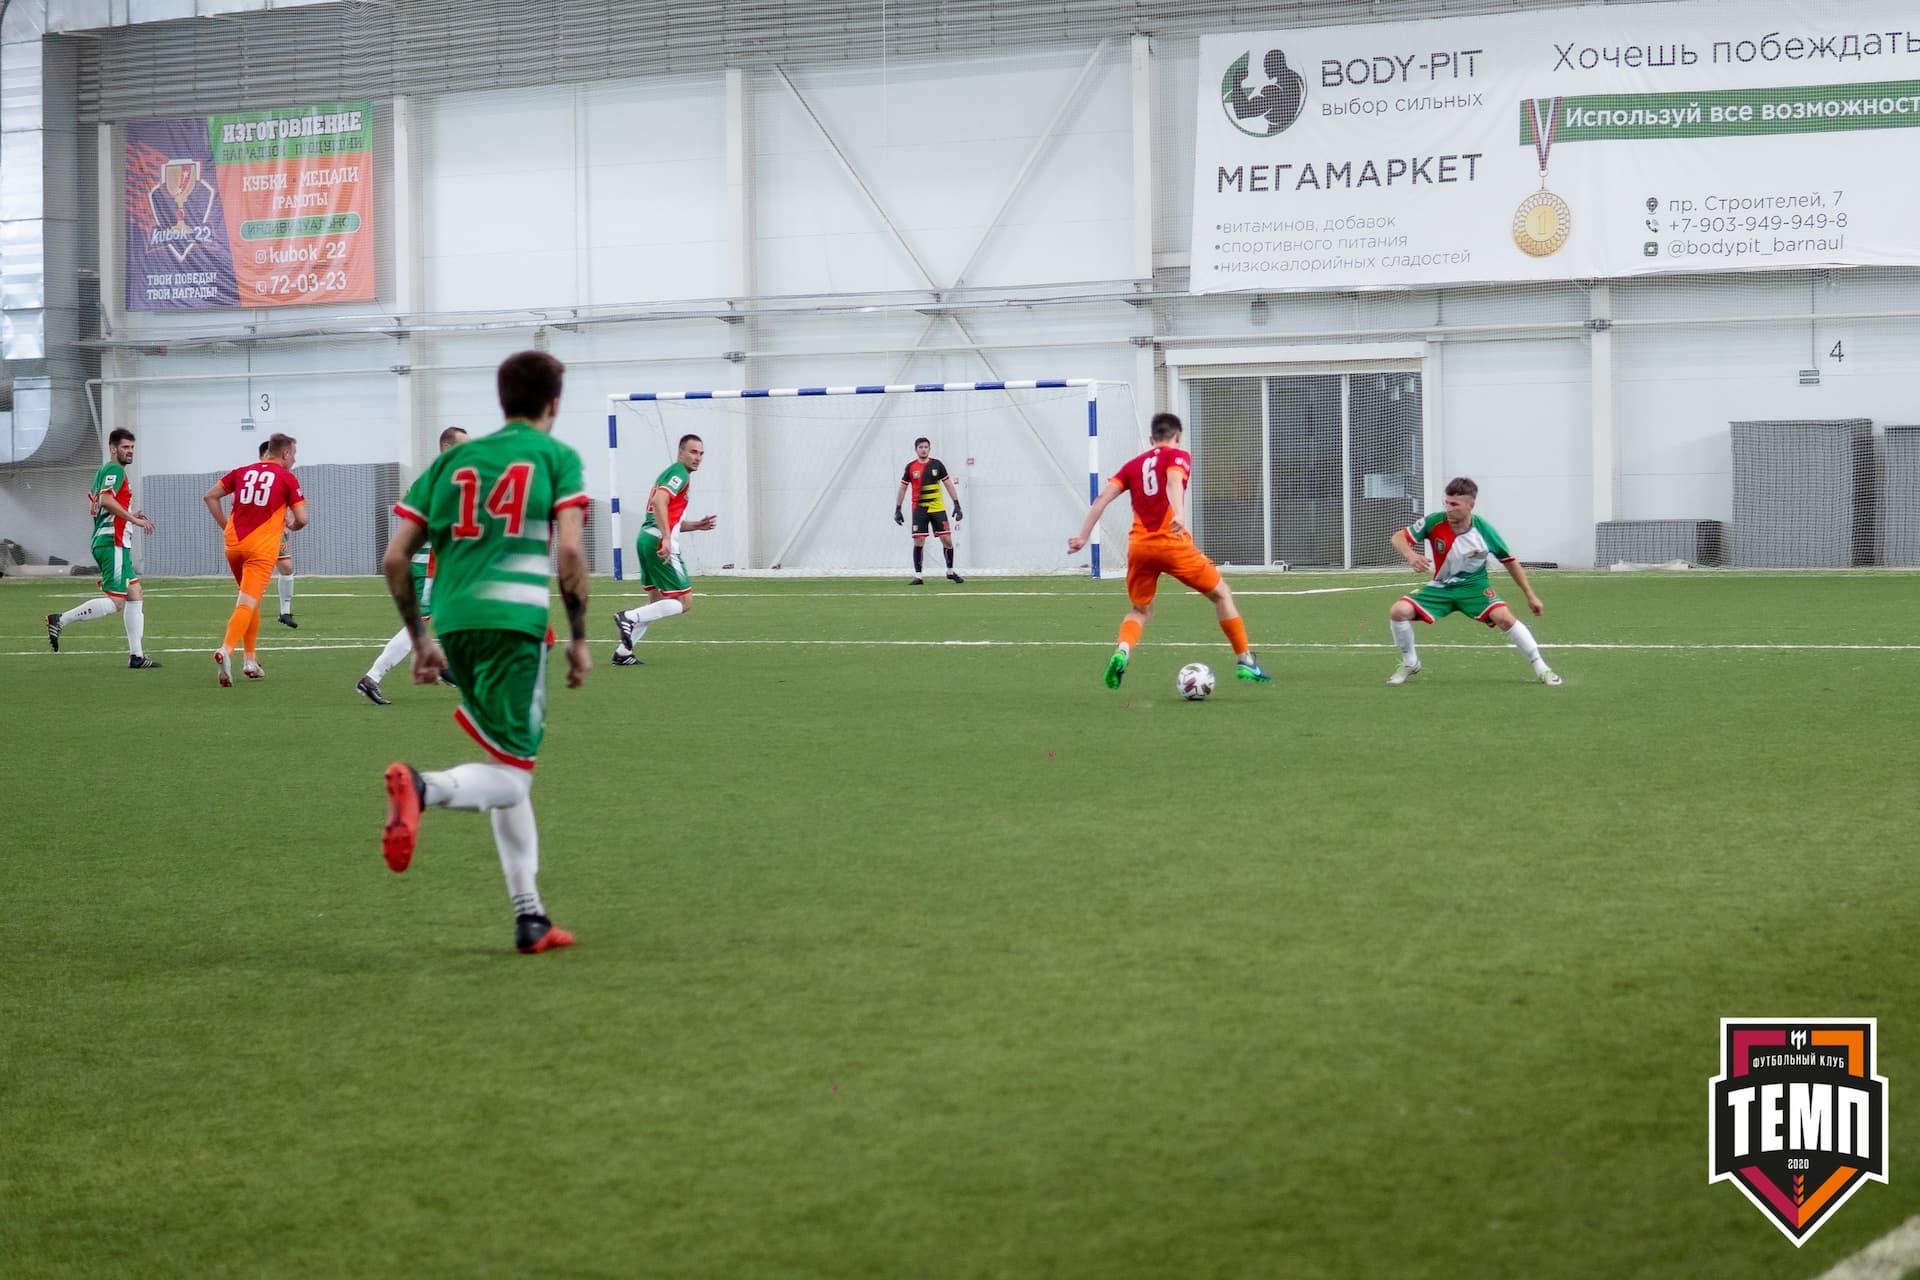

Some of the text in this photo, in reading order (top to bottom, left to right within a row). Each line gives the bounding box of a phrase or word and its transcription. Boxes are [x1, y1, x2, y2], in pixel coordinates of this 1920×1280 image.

[1553, 31, 1920, 72] Хочешь побеждать
[1321, 49, 1484, 88] BODY-PIT
[1321, 92, 1484, 117] выбор сильных
[1565, 102, 1702, 130] Используй
[1710, 104, 1754, 123] все
[222, 110, 362, 144] ИЗГОТОВЛЕНИЕ
[242, 166, 359, 193] КУБКИ МЕДАЛИ
[1217, 153, 1483, 193] МЕГАМАРКЕТ
[1668, 190, 1844, 214] пр. Строителей, 7
[1222, 215, 1397, 235] витаминов, добавок
[1668, 212, 1848, 233] +7-903-949-949-8
[269, 241, 347, 263] kubok_22
[1221, 235, 1408, 254] спортивного питания
[1667, 235, 1845, 258] @bodypit_barnaul
[1220, 250, 1472, 273] низкокалорийных сладостей
[146, 271, 217, 286] ТВОИ ПОБЕДЫ!
[270, 270, 347, 295] 72-03-23
[146, 286, 218, 300] ТВОИ НАГРАДЫ!
[1829, 339, 1845, 363] 4
[260, 393, 271, 412] 3
[240, 469, 276, 507] 33
[1141, 456, 1159, 497] 6
[451, 461, 536, 541] 14
